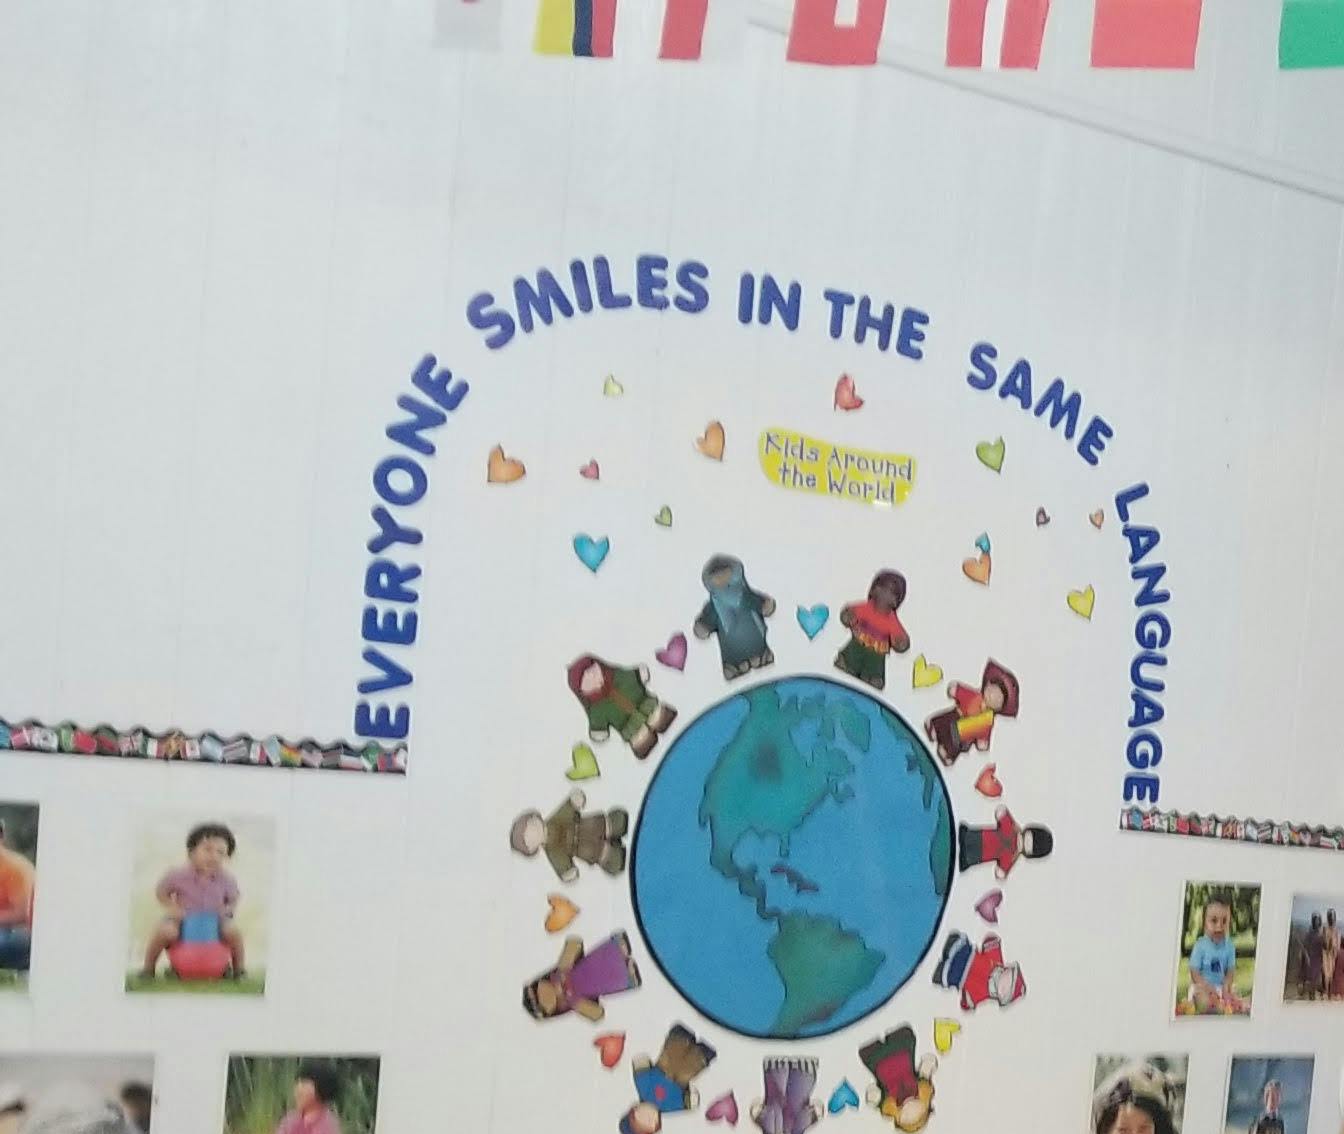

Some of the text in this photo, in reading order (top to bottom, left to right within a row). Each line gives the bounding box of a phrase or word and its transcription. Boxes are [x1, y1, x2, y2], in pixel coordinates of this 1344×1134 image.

[765, 431, 913, 481] Kids Around
[779, 461, 896, 504] the World
[354, 252, 1172, 803] EVERYONE SMILES IN THE SAME LANGUAGE
